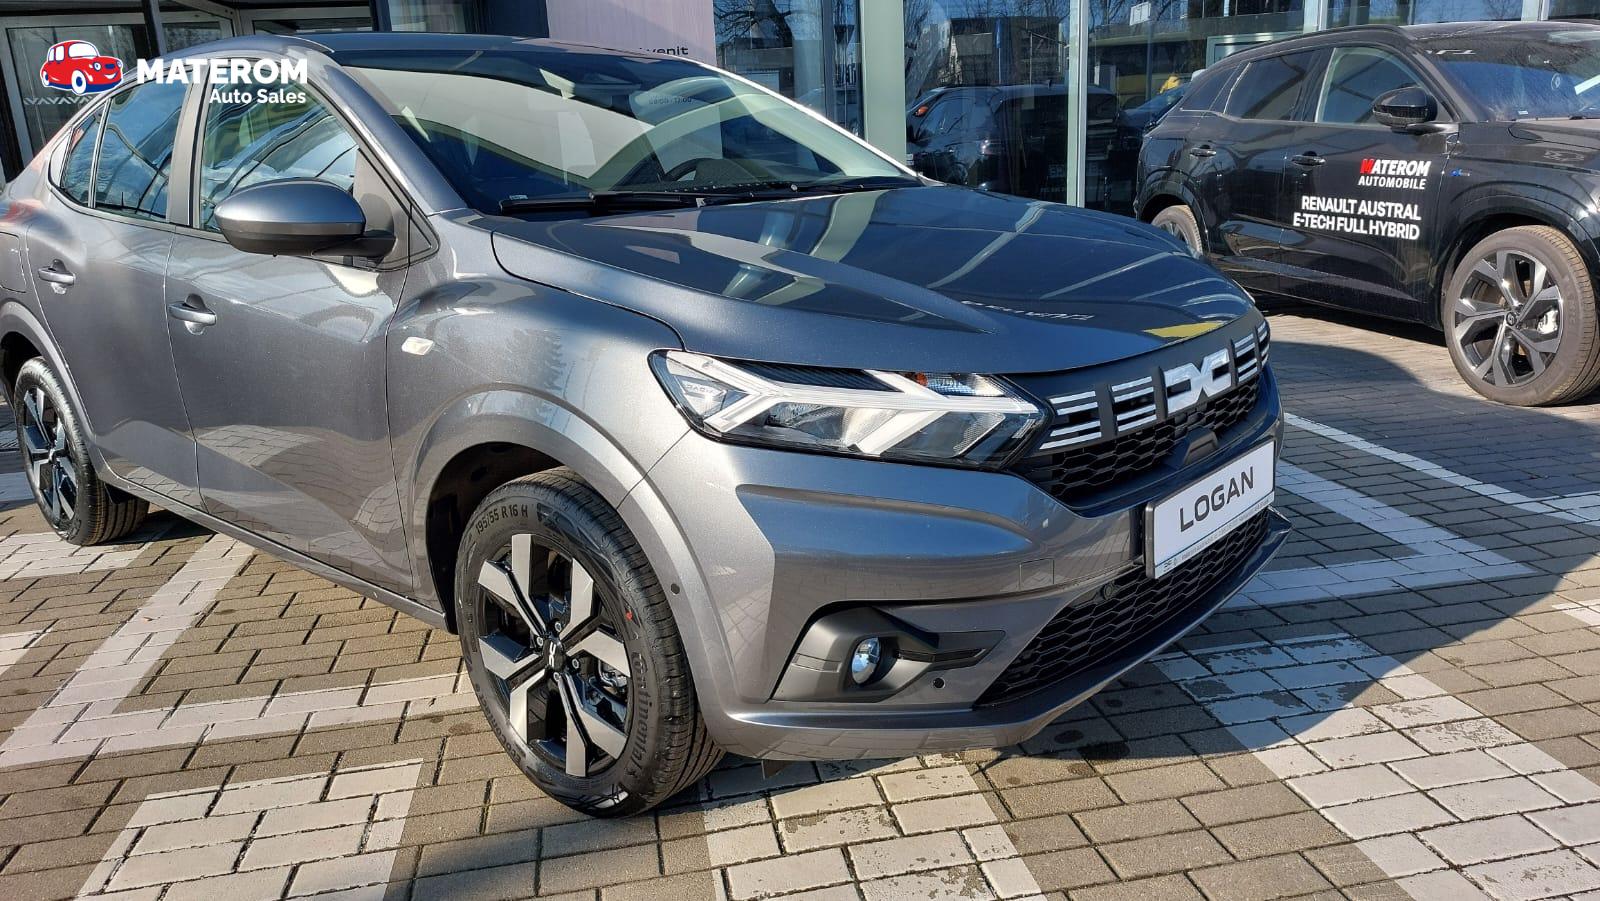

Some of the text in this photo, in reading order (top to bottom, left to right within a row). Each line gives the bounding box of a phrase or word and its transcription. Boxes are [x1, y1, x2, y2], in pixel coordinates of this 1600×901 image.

[1359, 158, 1432, 177] MATEROM
[1358, 176, 1427, 190] AUTOMOBILE
[1302, 195, 1422, 221] RENAULT AUSTRAL
[1293, 212, 1420, 240] E-TECH FULL HYBRID
[1179, 466, 1254, 532] LOGAN
[475, 504, 528, 534] 195/55 R 16 H
